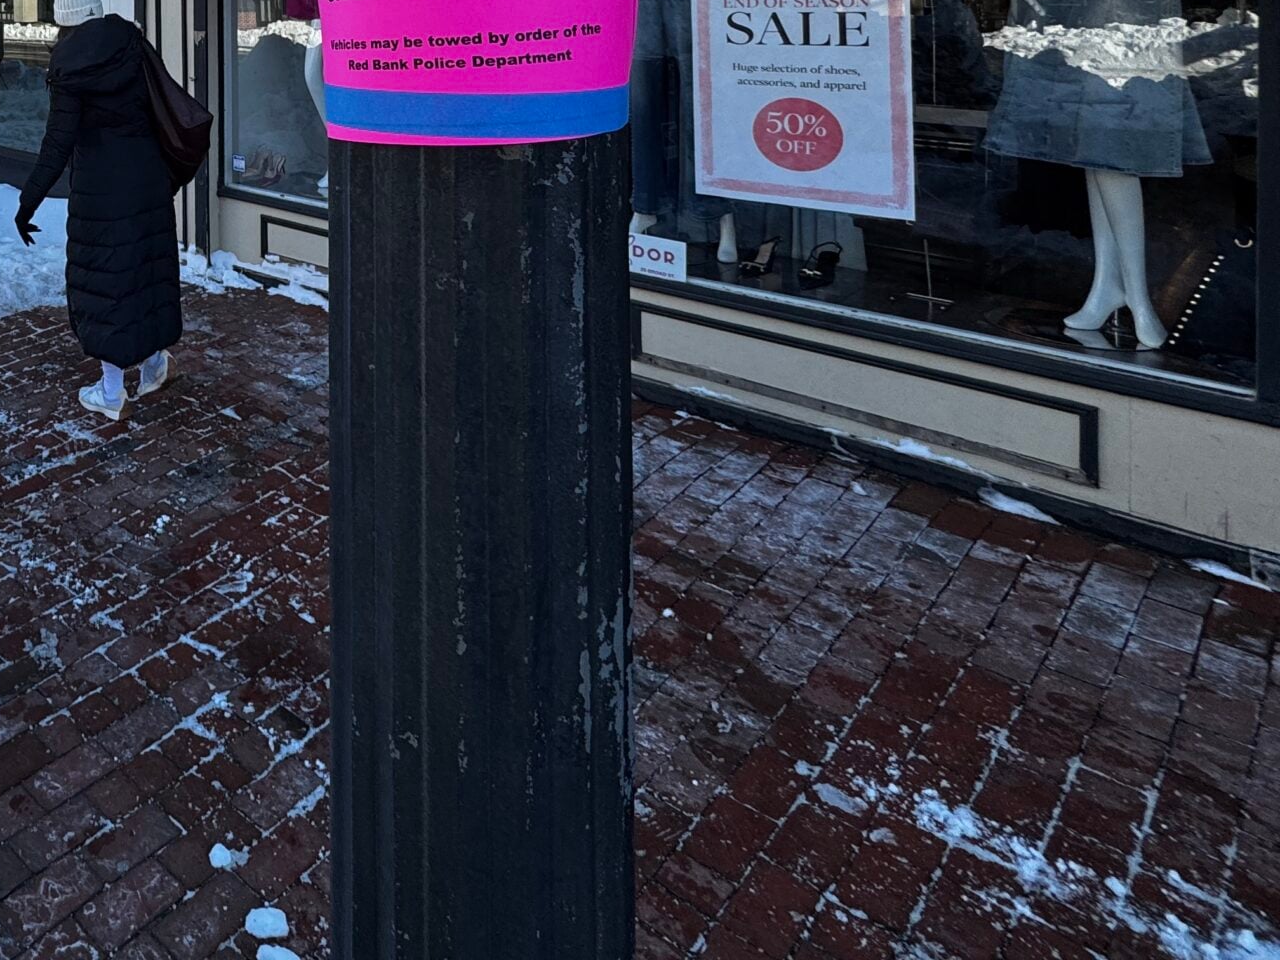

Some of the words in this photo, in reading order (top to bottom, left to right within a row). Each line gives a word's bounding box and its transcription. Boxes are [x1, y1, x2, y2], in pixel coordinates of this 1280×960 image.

[330, 38, 367, 51] Vehicles
[370, 40, 399, 52] may
[403, 36, 423, 48] be
[428, 32, 483, 47] towed
[488, 30, 509, 46] by
[515, 27, 559, 42] order
[563, 24, 578, 38] of
[581, 23, 601, 37] the
[726, 10, 870, 47] SALE
[348, 58, 369, 71] Red
[372, 58, 409, 71] Bank
[413, 55, 467, 70] Police
[472, 49, 573, 69] Department
[732, 62, 759, 74] Huge
[760, 63, 808, 74] selection
[810, 64, 824, 74] of
[824, 65, 861, 77] shoes,
[737, 78, 797, 88] accessories,
[799, 80, 820, 89] and
[823, 81, 867, 92] apparel
[765, 111, 828, 137] 50%
[776, 139, 817, 155] OFF
[632, 245, 675, 265] DOR
